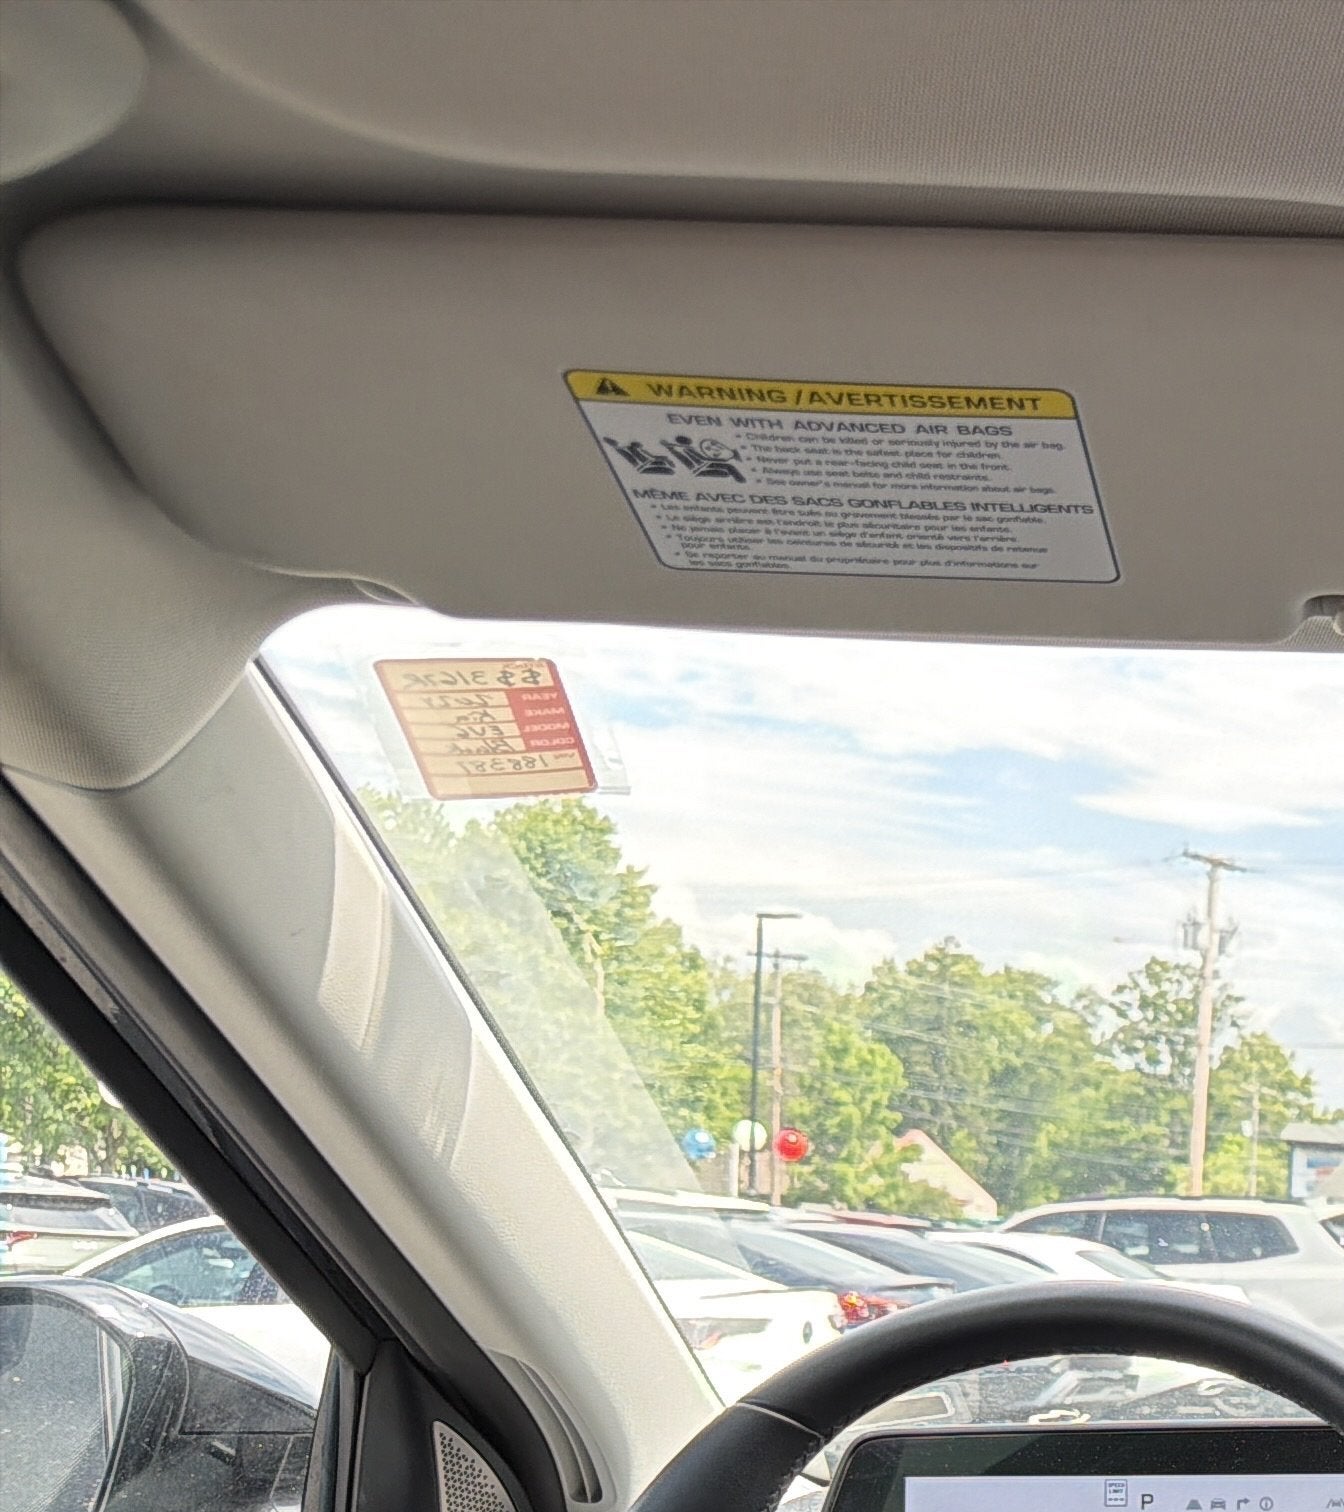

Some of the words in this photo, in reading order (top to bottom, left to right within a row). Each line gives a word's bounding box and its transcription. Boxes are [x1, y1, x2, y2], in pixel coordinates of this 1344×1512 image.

[667, 413, 722, 427] EVEN
[730, 417, 783, 430] WITH
[794, 420, 906, 434] ADVANCED
[915, 424, 948, 435] AIR
[957, 425, 1013, 436] BAGS
[633, 488, 689, 501] MÊME
[695, 492, 747, 505] AVEC
[750, 495, 787, 506] DES
[791, 496, 844, 508] SACS
[847, 498, 968, 513] GONFLABLES
[971, 501, 1094, 515] INTELLIGENTS
[1141, 1494, 1155, 1510] P
